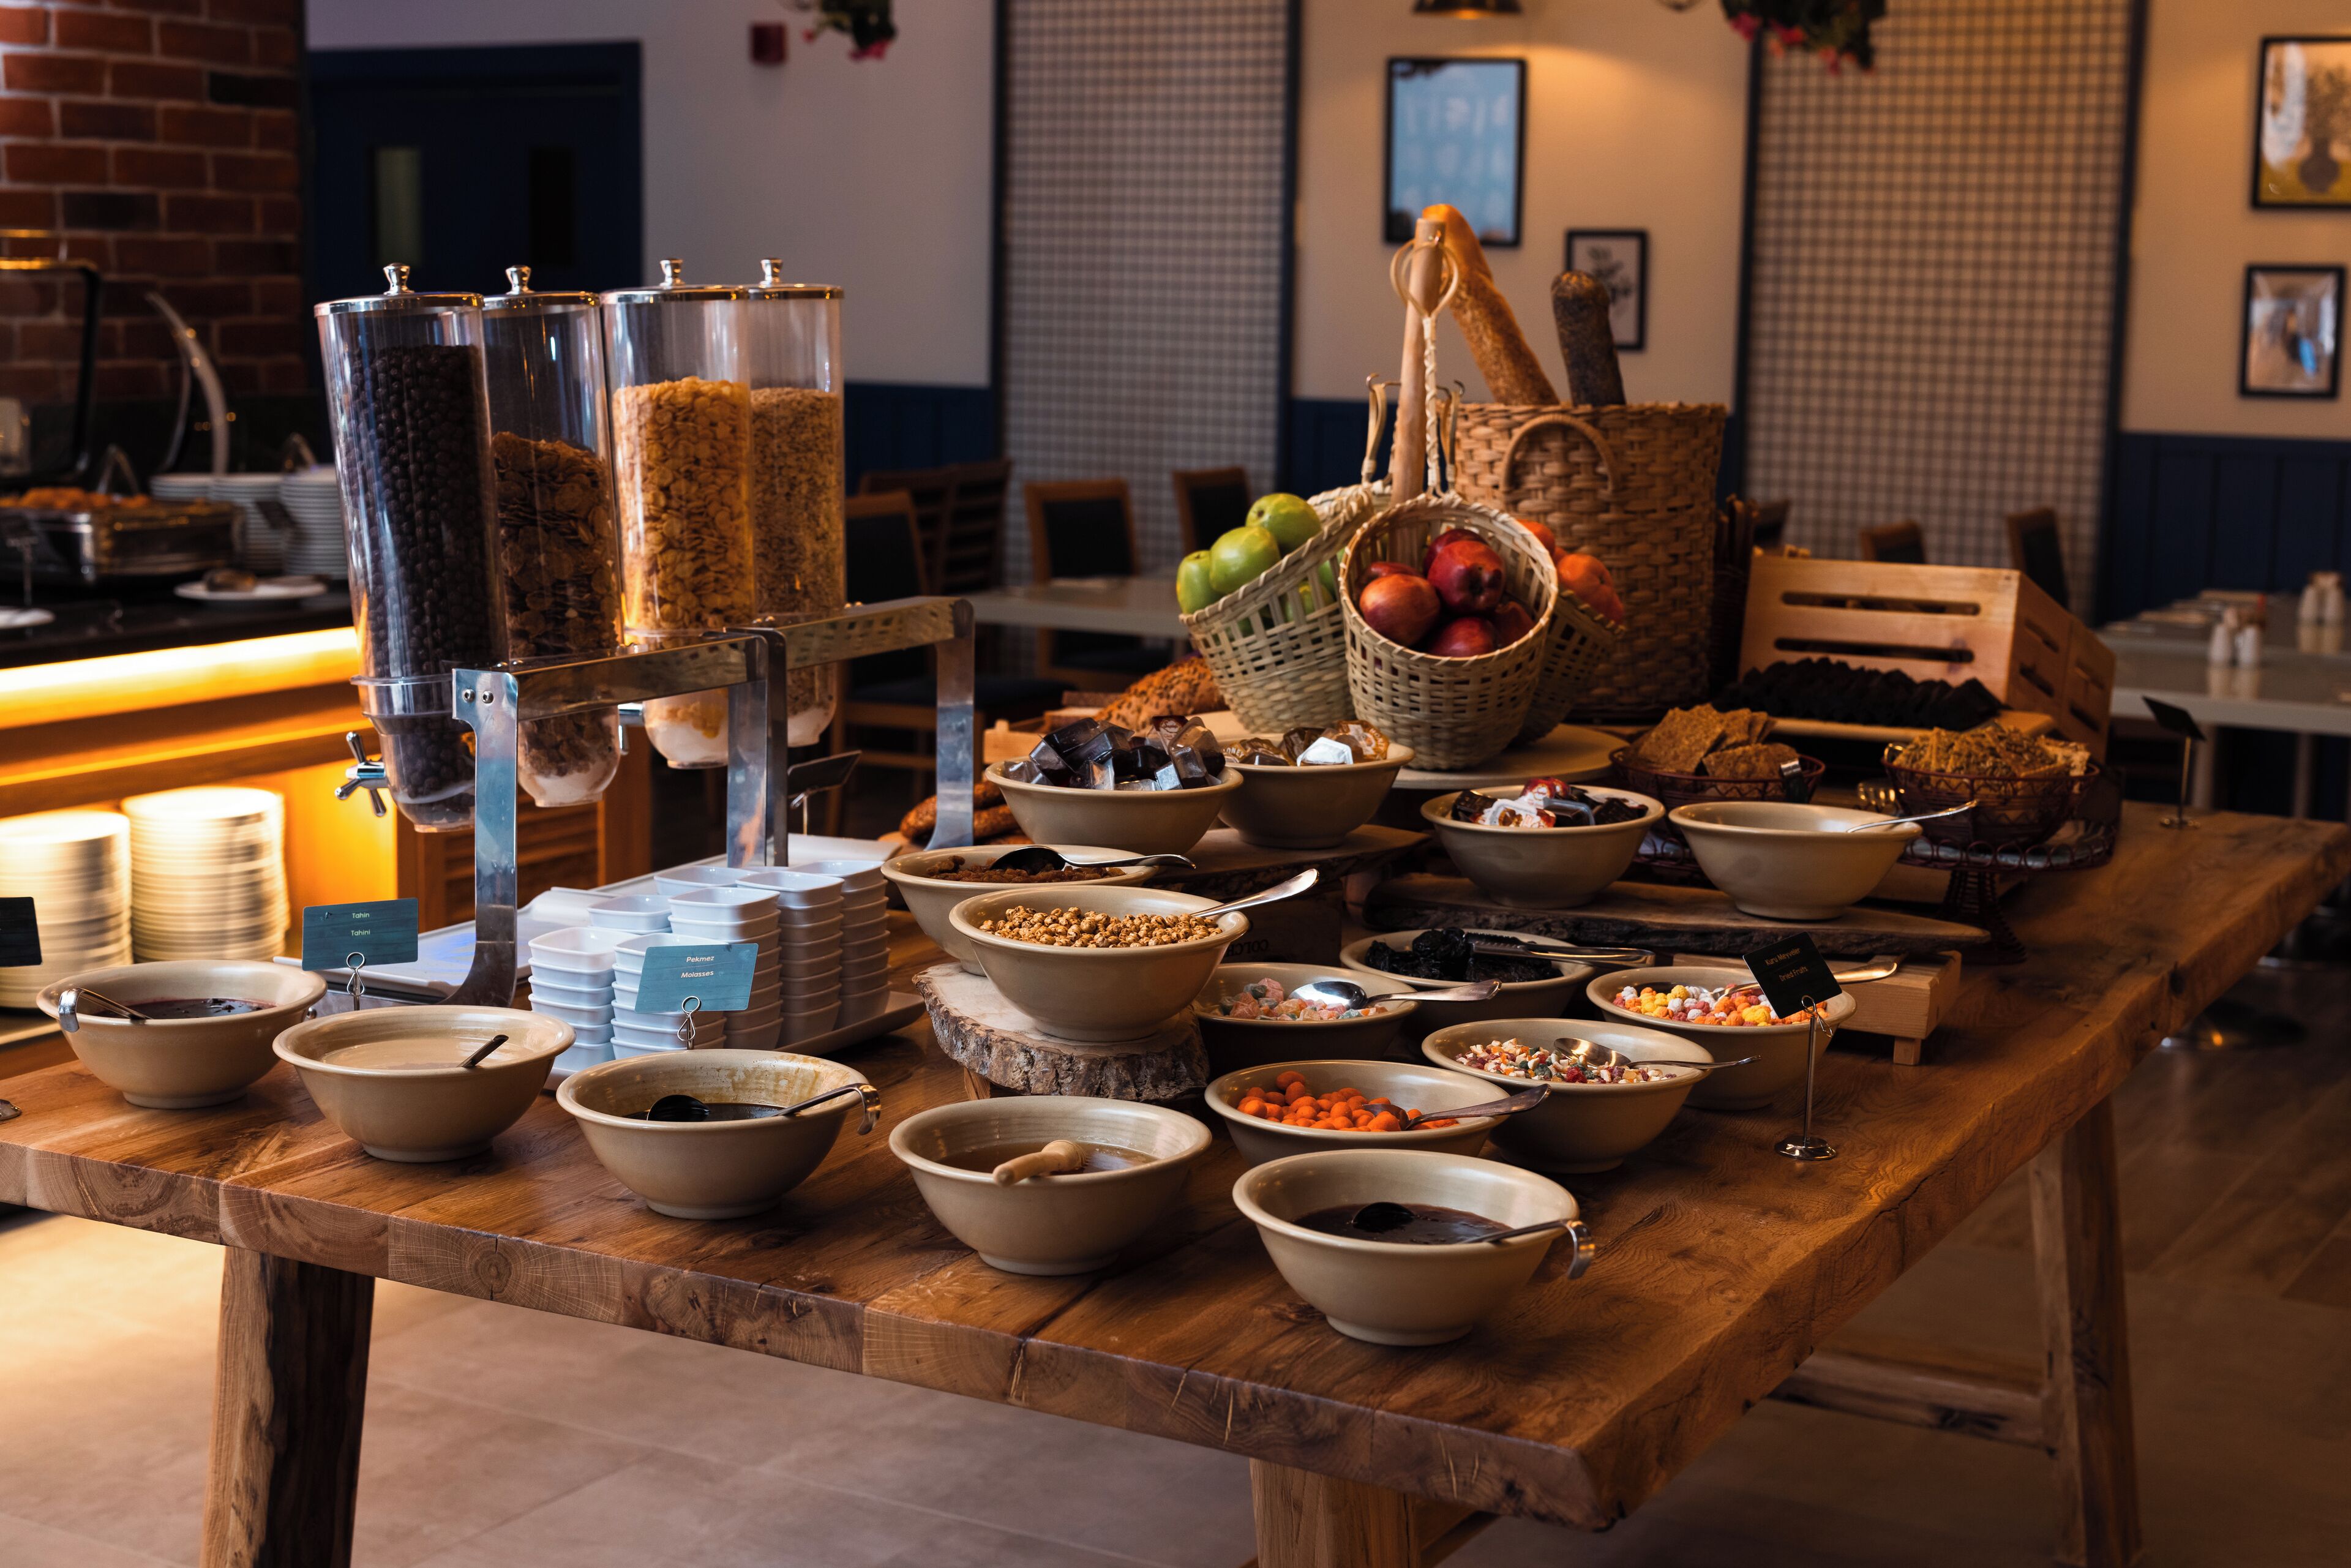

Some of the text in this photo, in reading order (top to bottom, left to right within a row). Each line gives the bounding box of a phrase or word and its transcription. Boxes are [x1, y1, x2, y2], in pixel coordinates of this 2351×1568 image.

[1764, 948, 1801, 966] Kuru Meyveler
[1779, 966, 1809, 981] Dried Fruits
